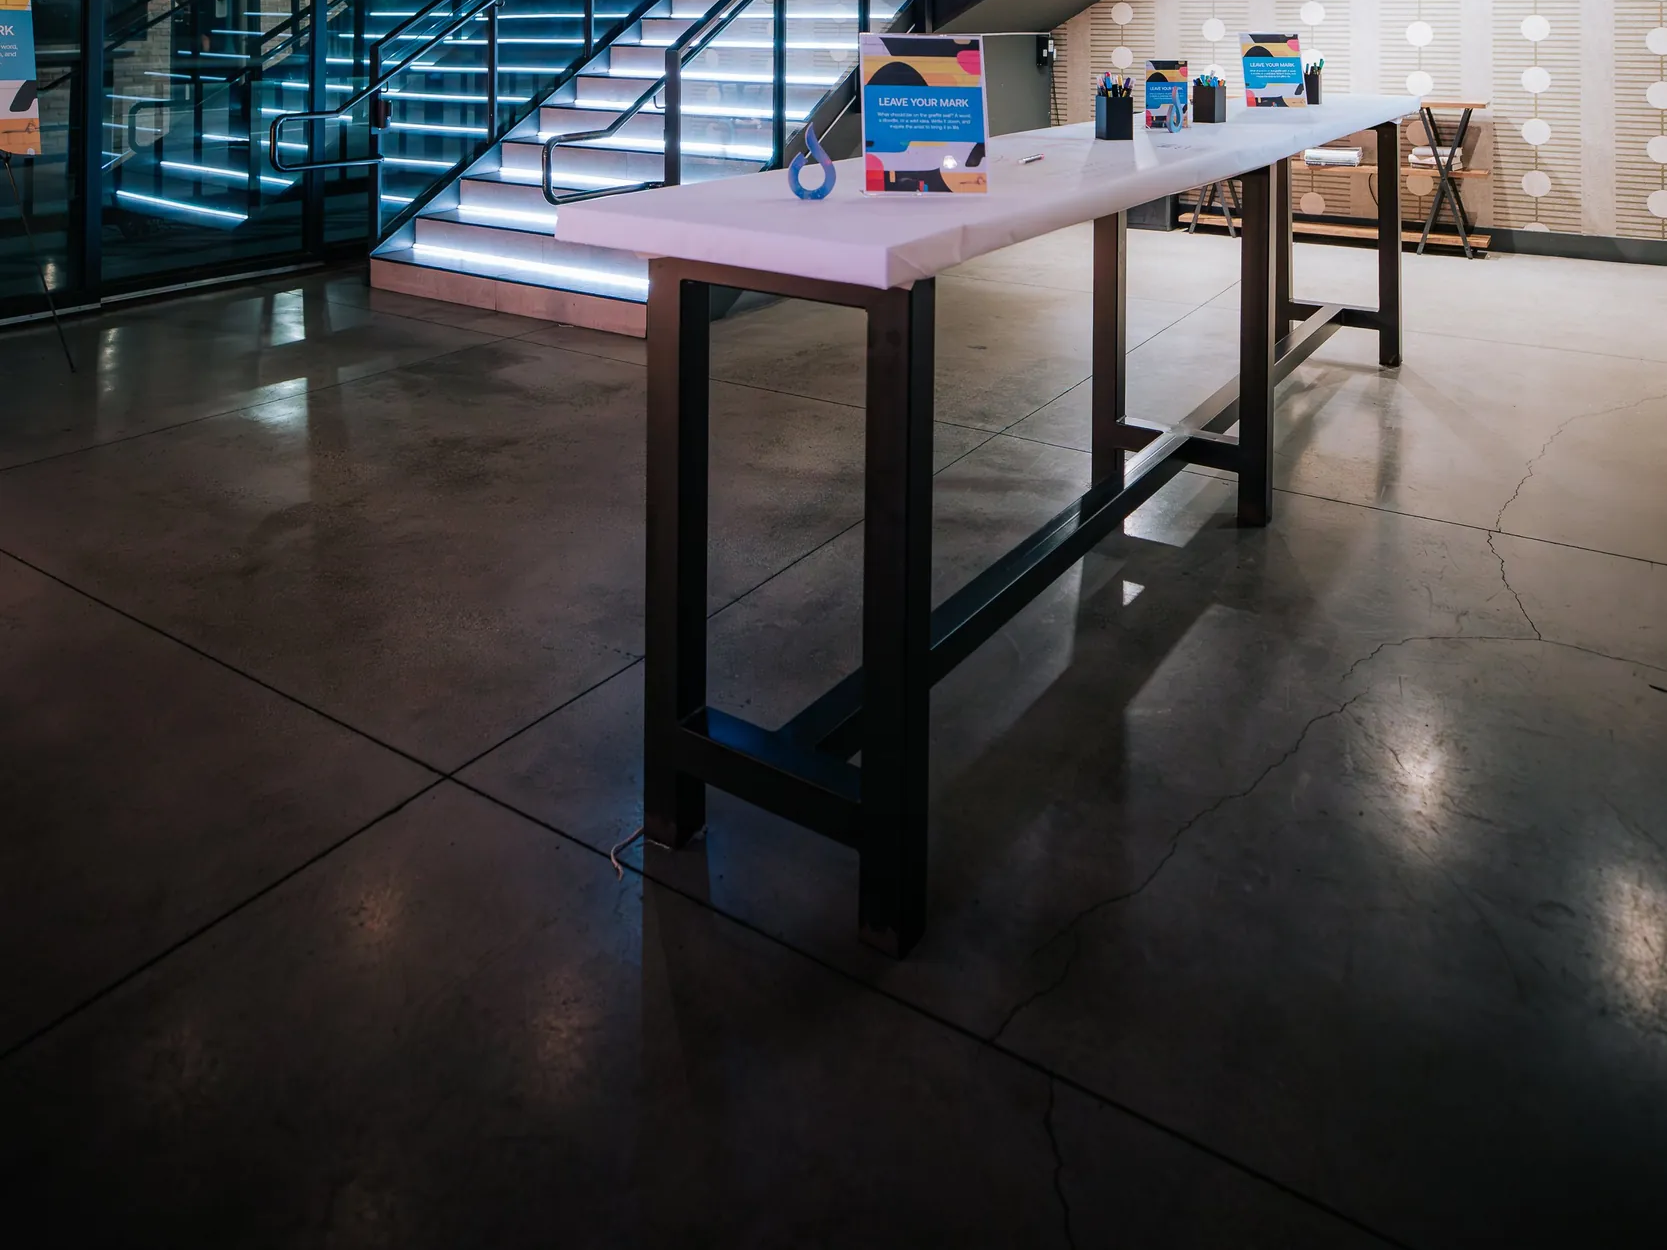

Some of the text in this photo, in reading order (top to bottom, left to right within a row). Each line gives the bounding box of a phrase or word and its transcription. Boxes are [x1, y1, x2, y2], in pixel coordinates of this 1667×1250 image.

[878, 97, 968, 107] LEAVE YOUR MARK
